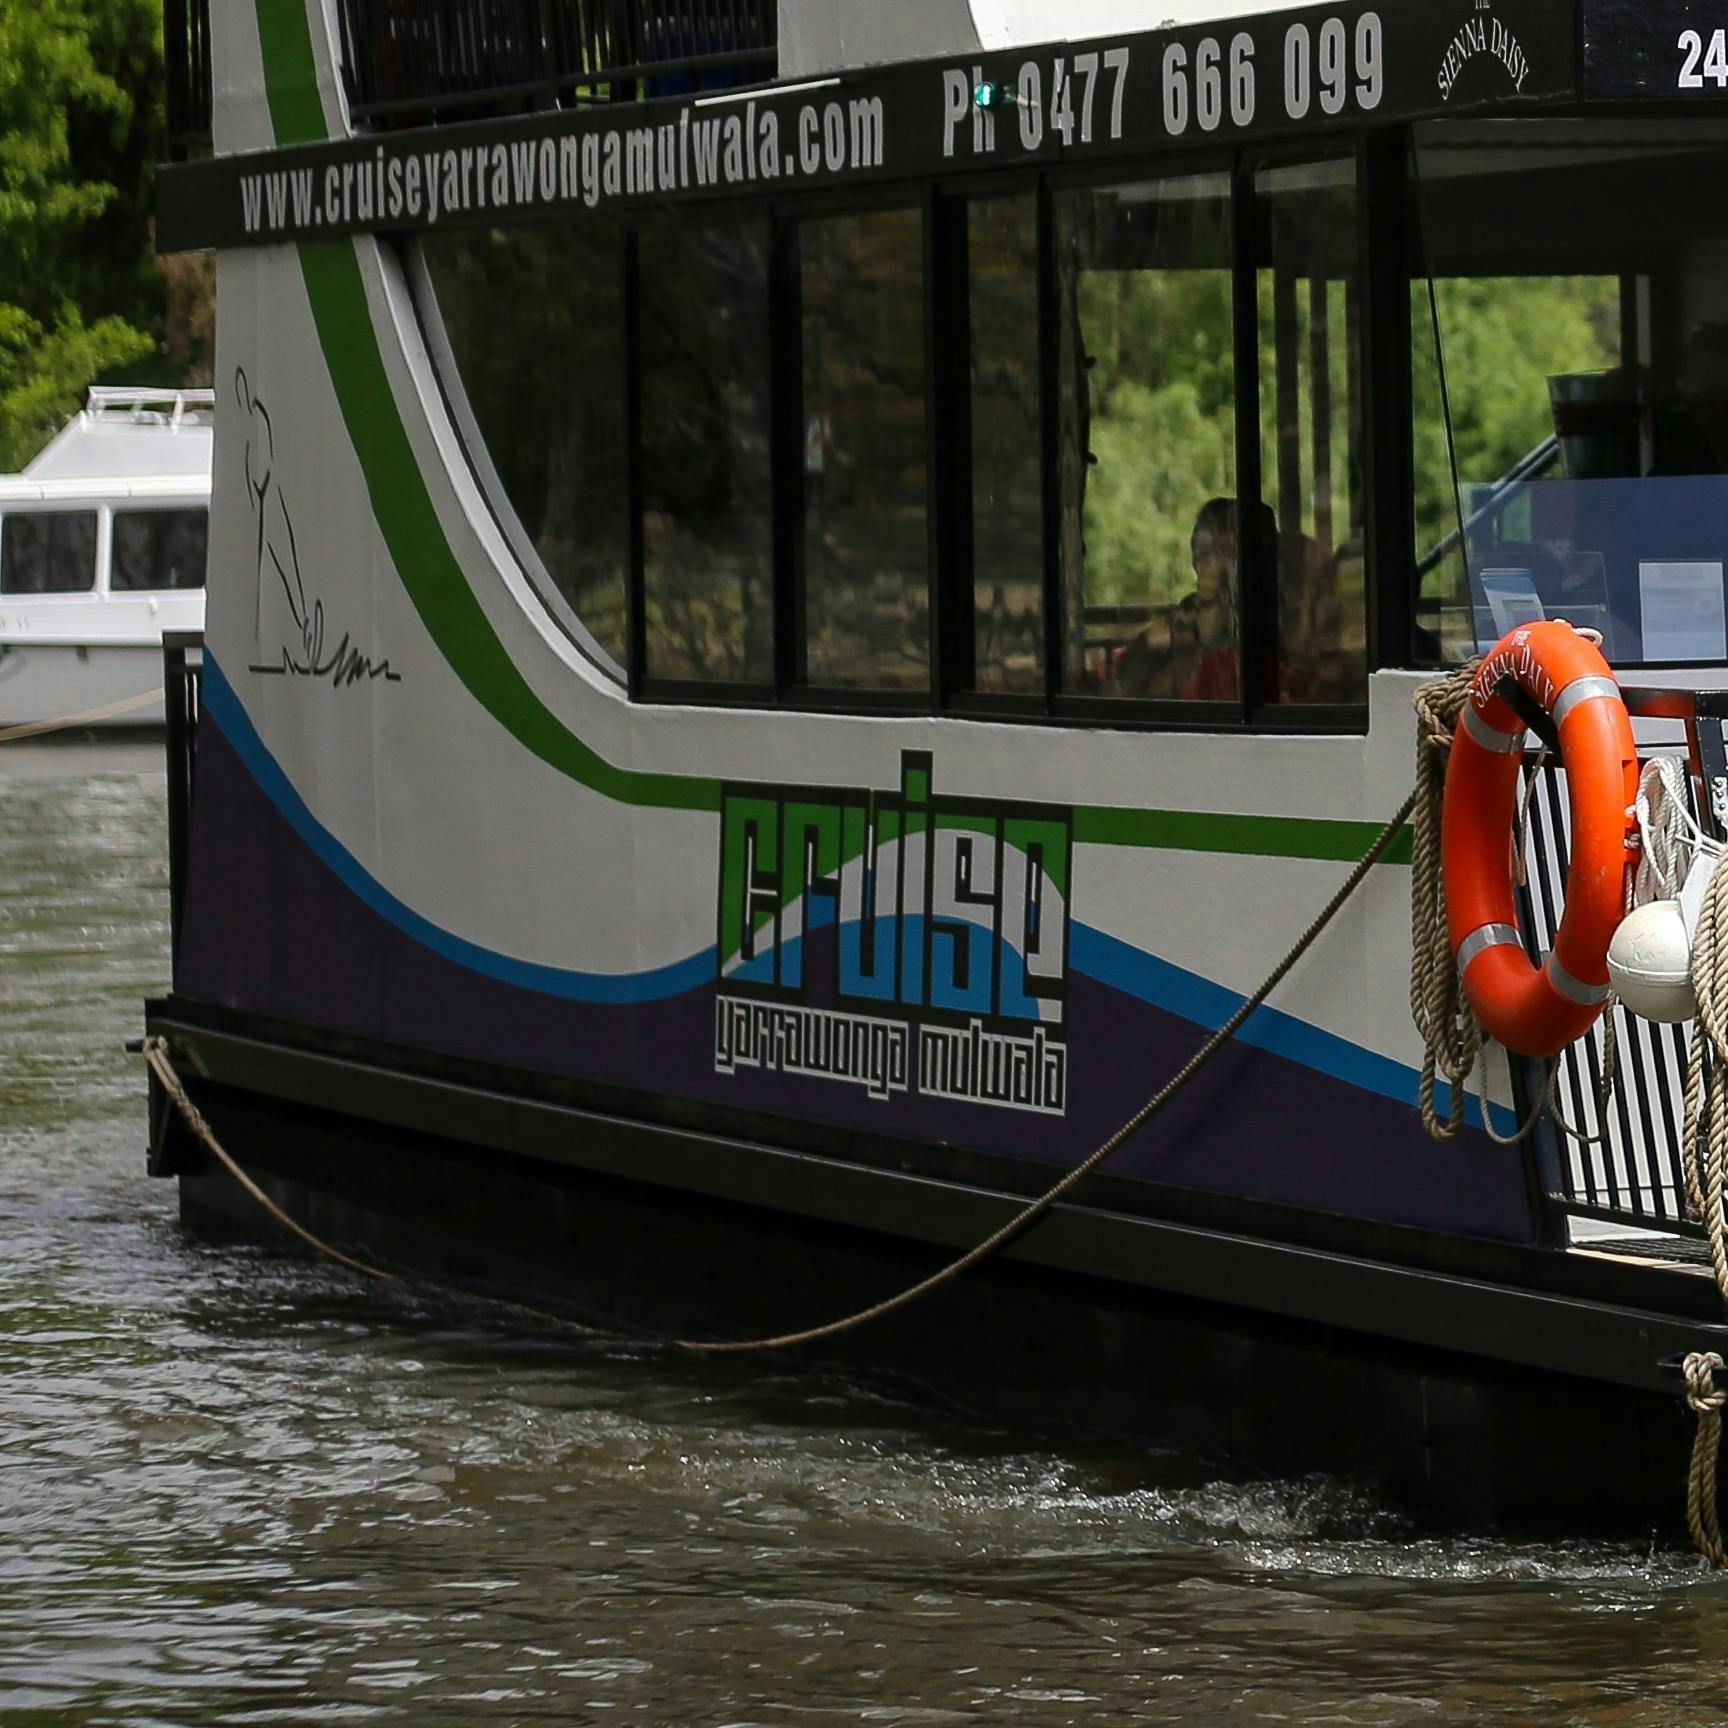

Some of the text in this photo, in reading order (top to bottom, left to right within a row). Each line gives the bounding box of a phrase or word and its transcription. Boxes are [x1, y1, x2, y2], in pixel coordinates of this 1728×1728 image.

[1437, 16, 1529, 101] SIENNA DAISY
[240, 11, 1383, 232] www.cruiseyarrawongamulwala.com Ph 0477 666 099
[715, 995, 909, 1101] yarrawonga
